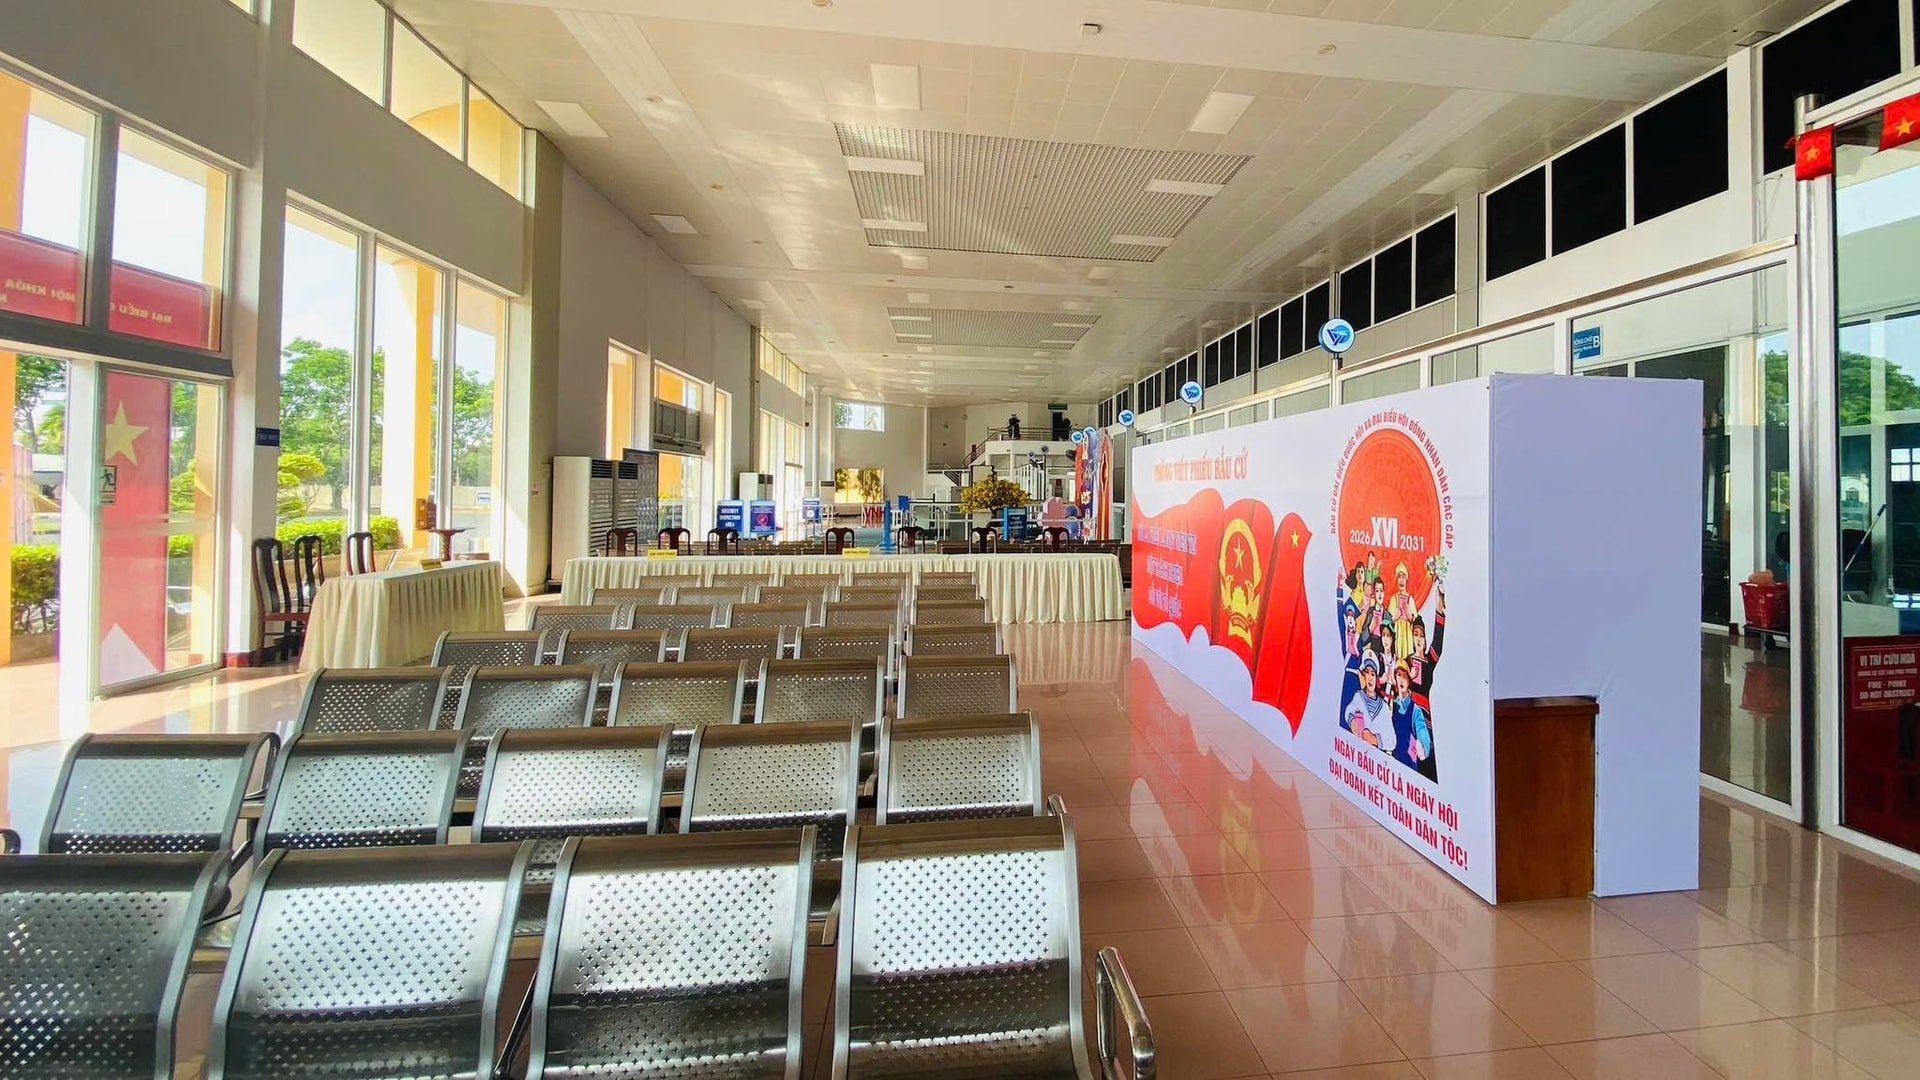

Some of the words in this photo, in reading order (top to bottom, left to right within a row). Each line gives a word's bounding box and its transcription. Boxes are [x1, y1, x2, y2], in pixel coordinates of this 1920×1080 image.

[1592, 335, 1600, 348] B
[1383, 406, 1397, 423] BIỂU
[1398, 411, 1409, 430] HỘI
[1408, 418, 1426, 443] ĐỒNG
[1214, 445, 1232, 480] BẦU
[1234, 444, 1249, 479] CỬ
[1424, 438, 1441, 469] NHÂN
[1436, 467, 1450, 494] DÂN
[1442, 495, 1453, 521] CÁC
[1350, 529, 1371, 546] 2026
[1370, 516, 1398, 549] XVI
[1400, 534, 1424, 552] 2031
[1445, 523, 1454, 549] CẤP
[1334, 736, 1355, 763] NGÀY
[1357, 750, 1374, 776] BẦU
[1377, 760, 1390, 785] CỬ
[1392, 772, 1403, 796] LÀ
[1406, 781, 1435, 816] NGÀY
[1438, 802, 1458, 832] HỘI
[1329, 757, 1342, 781] ĐẠI
[1344, 768, 1366, 797] ĐOÀN
[1368, 784, 1384, 810] KẾT
[1387, 797, 1412, 831] TOÀN
[1415, 819, 1438, 850] DÂN
[1441, 834, 1468, 871] TỘC!
